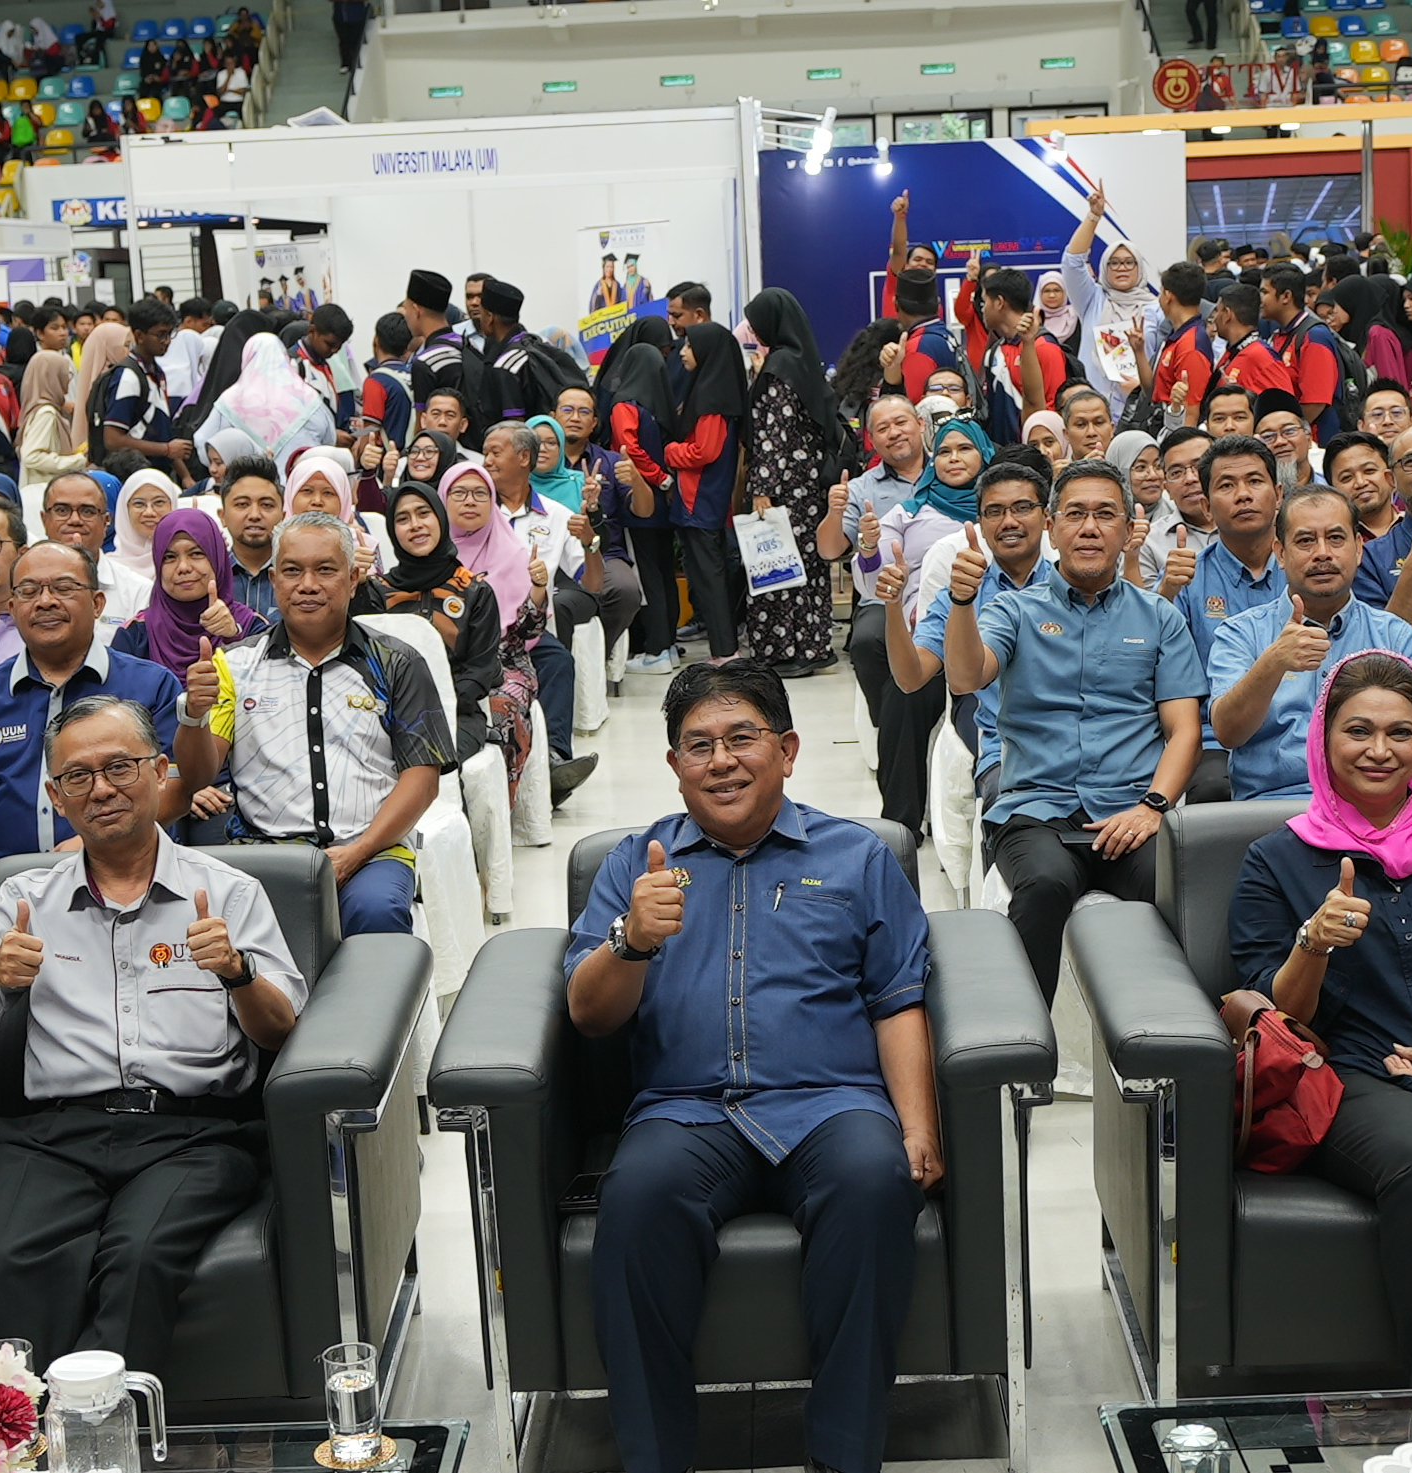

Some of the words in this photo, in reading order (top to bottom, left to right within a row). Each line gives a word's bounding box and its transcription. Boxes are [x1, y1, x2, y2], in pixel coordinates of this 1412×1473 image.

[1205, 62, 1302, 98] UTM
[372, 150, 430, 175] UNIVERSITI
[432, 148, 474, 172] MALAYA
[475, 147, 498, 175] (UM)
[2, 723, 27, 737] UUM
